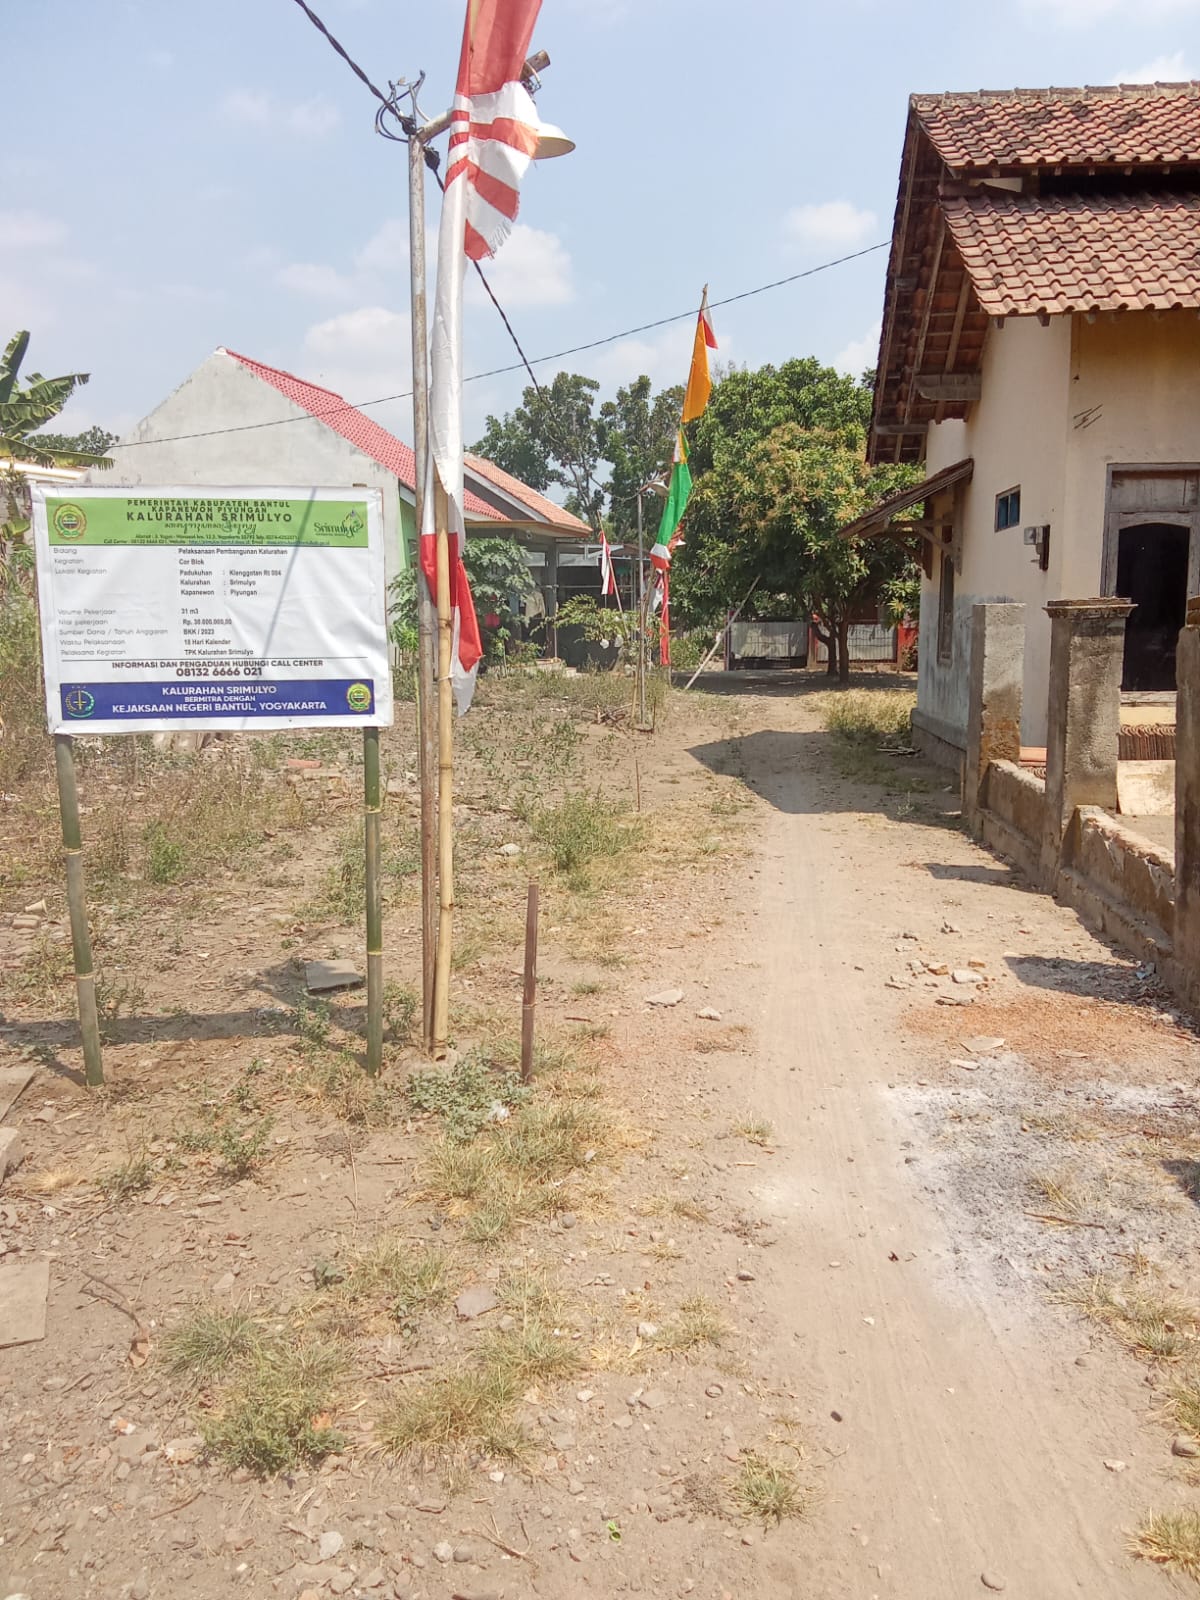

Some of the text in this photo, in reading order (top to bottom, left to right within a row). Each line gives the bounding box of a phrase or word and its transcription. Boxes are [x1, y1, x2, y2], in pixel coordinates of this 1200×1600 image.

[127, 512, 292, 522] KALURAHAN SRIMULYO
[176, 667, 262, 677] 08132 6666 021
[162, 686, 277, 695] KALURAHAN SRIMULYO
[112, 702, 327, 713] KEJAKSAAN NEGERI BANTUL, YOGYAKARTA
